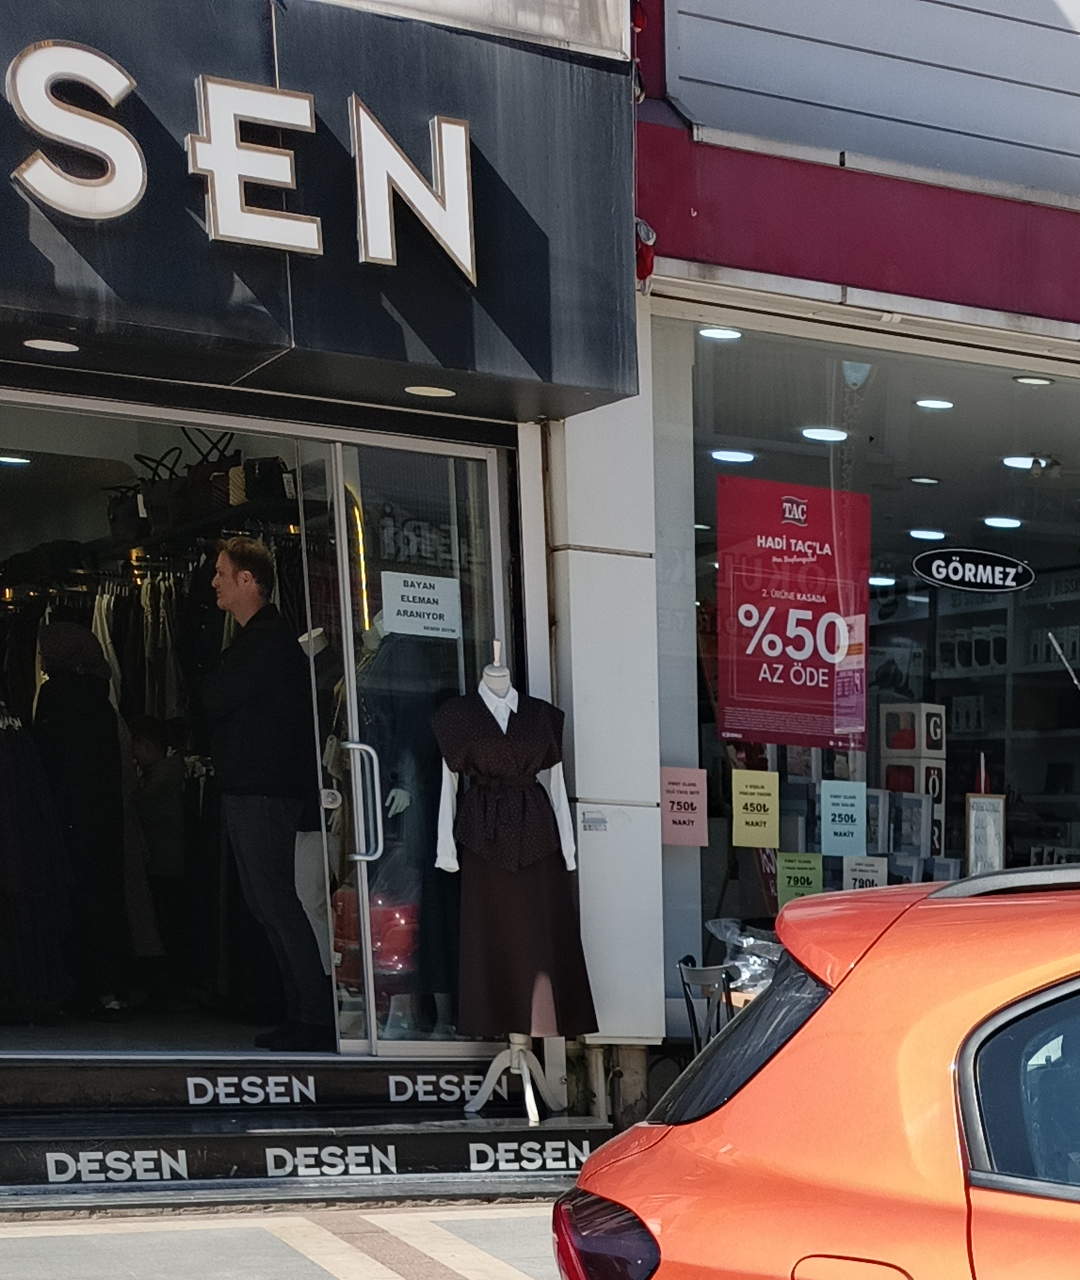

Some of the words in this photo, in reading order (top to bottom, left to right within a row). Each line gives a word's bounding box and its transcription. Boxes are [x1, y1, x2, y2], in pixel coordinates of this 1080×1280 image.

[782, 502, 807, 522] TAÇ
[757, 534, 786, 550] HADİ
[790, 539, 832, 557] TAÇ'LA
[932, 556, 1017, 587] GÖRMEZ
[403, 580, 435, 590] BAYAN
[400, 594, 439, 605] ELEMAN
[796, 592, 827, 603] KASADA
[396, 609, 445, 621] ARANIYOR
[737, 603, 849, 664] %50
[758, 663, 784, 683] AZ
[790, 662, 829, 688] ÖDE
[669, 801, 697, 812] 750₺
[742, 802, 769, 813] 450₺
[672, 819, 695, 827] NAKİT
[831, 813, 857, 823] 250₺
[745, 820, 767, 828] NAKİT
[833, 830, 855, 838] NAKİT
[186, 1076, 316, 1103] DESEN
[46, 1148, 189, 1183] DESEN
[266, 1145, 397, 1176] DESEN
[469, 1140, 590, 1171] DESEN
